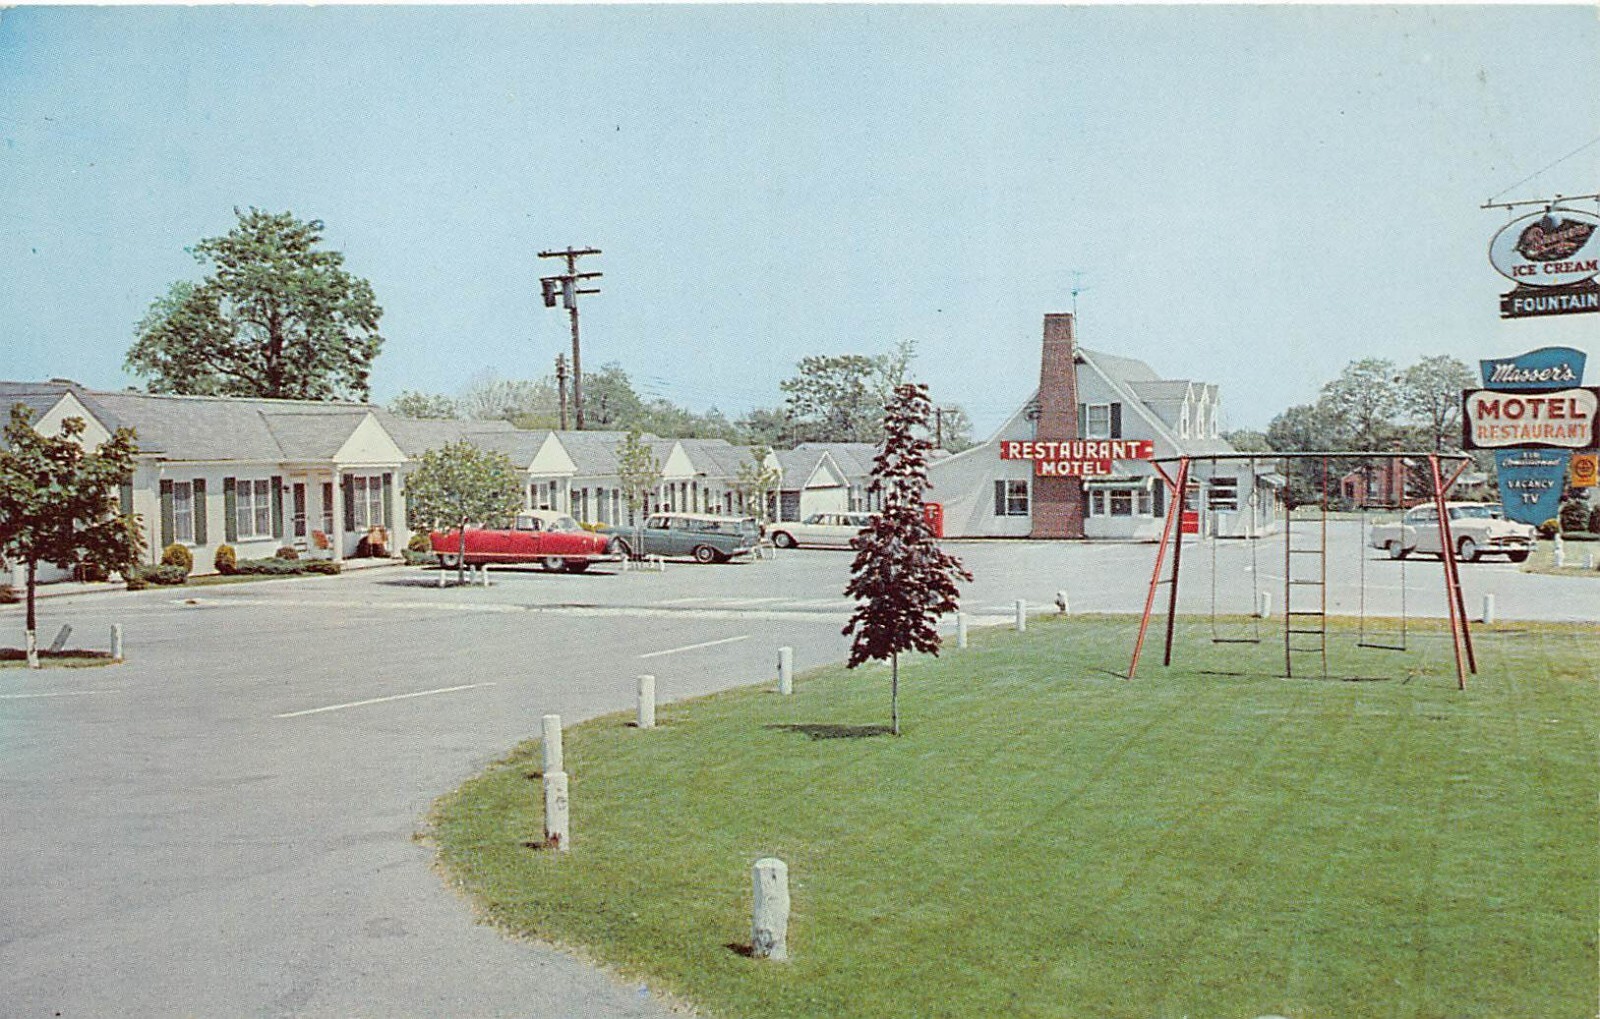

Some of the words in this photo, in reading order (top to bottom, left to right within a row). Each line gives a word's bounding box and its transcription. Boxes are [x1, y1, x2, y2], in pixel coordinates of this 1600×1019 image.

[1512, 264, 1536, 277] ICE
[1543, 259, 1598, 275] CREAM
[1513, 293, 1598, 312] FOUNTAIN
[1490, 363, 1577, 382] Masser's
[1476, 398, 1588, 420] MOTEL
[1477, 423, 1588, 439] RESTAURANT
[1008, 442, 1141, 459] RESTAURANT
[1041, 461, 1107, 475] MOTEL
[1507, 480, 1554, 489] VACANCY
[1522, 493, 1539, 504] TV
